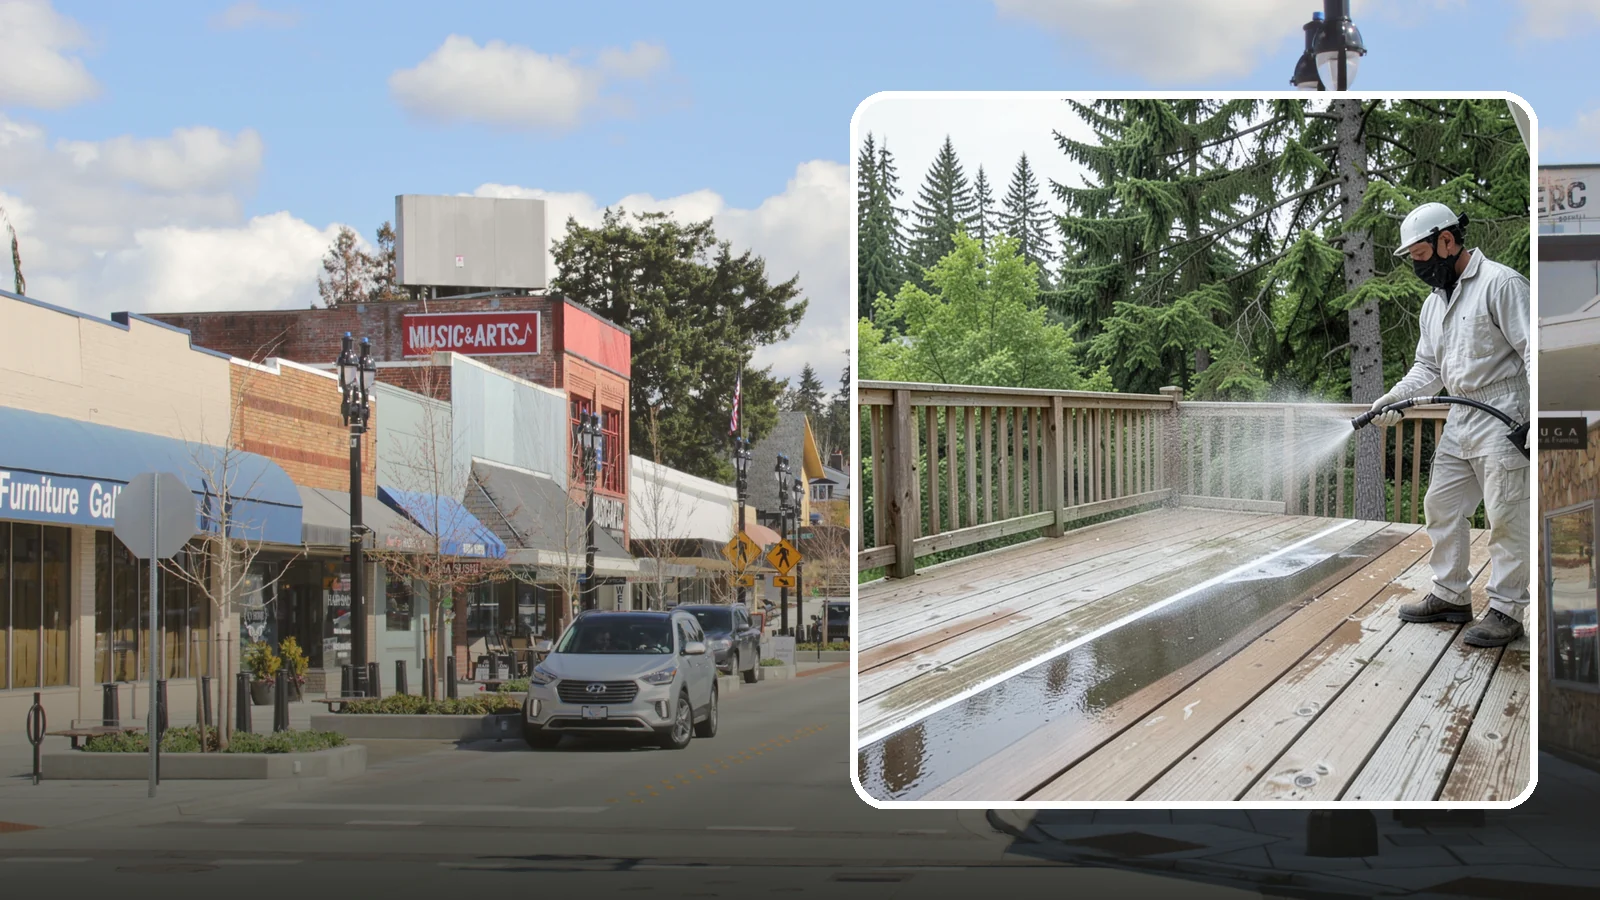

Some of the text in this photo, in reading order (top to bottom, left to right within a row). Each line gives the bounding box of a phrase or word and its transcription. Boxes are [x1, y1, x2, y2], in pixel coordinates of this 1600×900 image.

[0, 471, 121, 519] Furniture Gal
[453, 563, 479, 574] SUSHI
